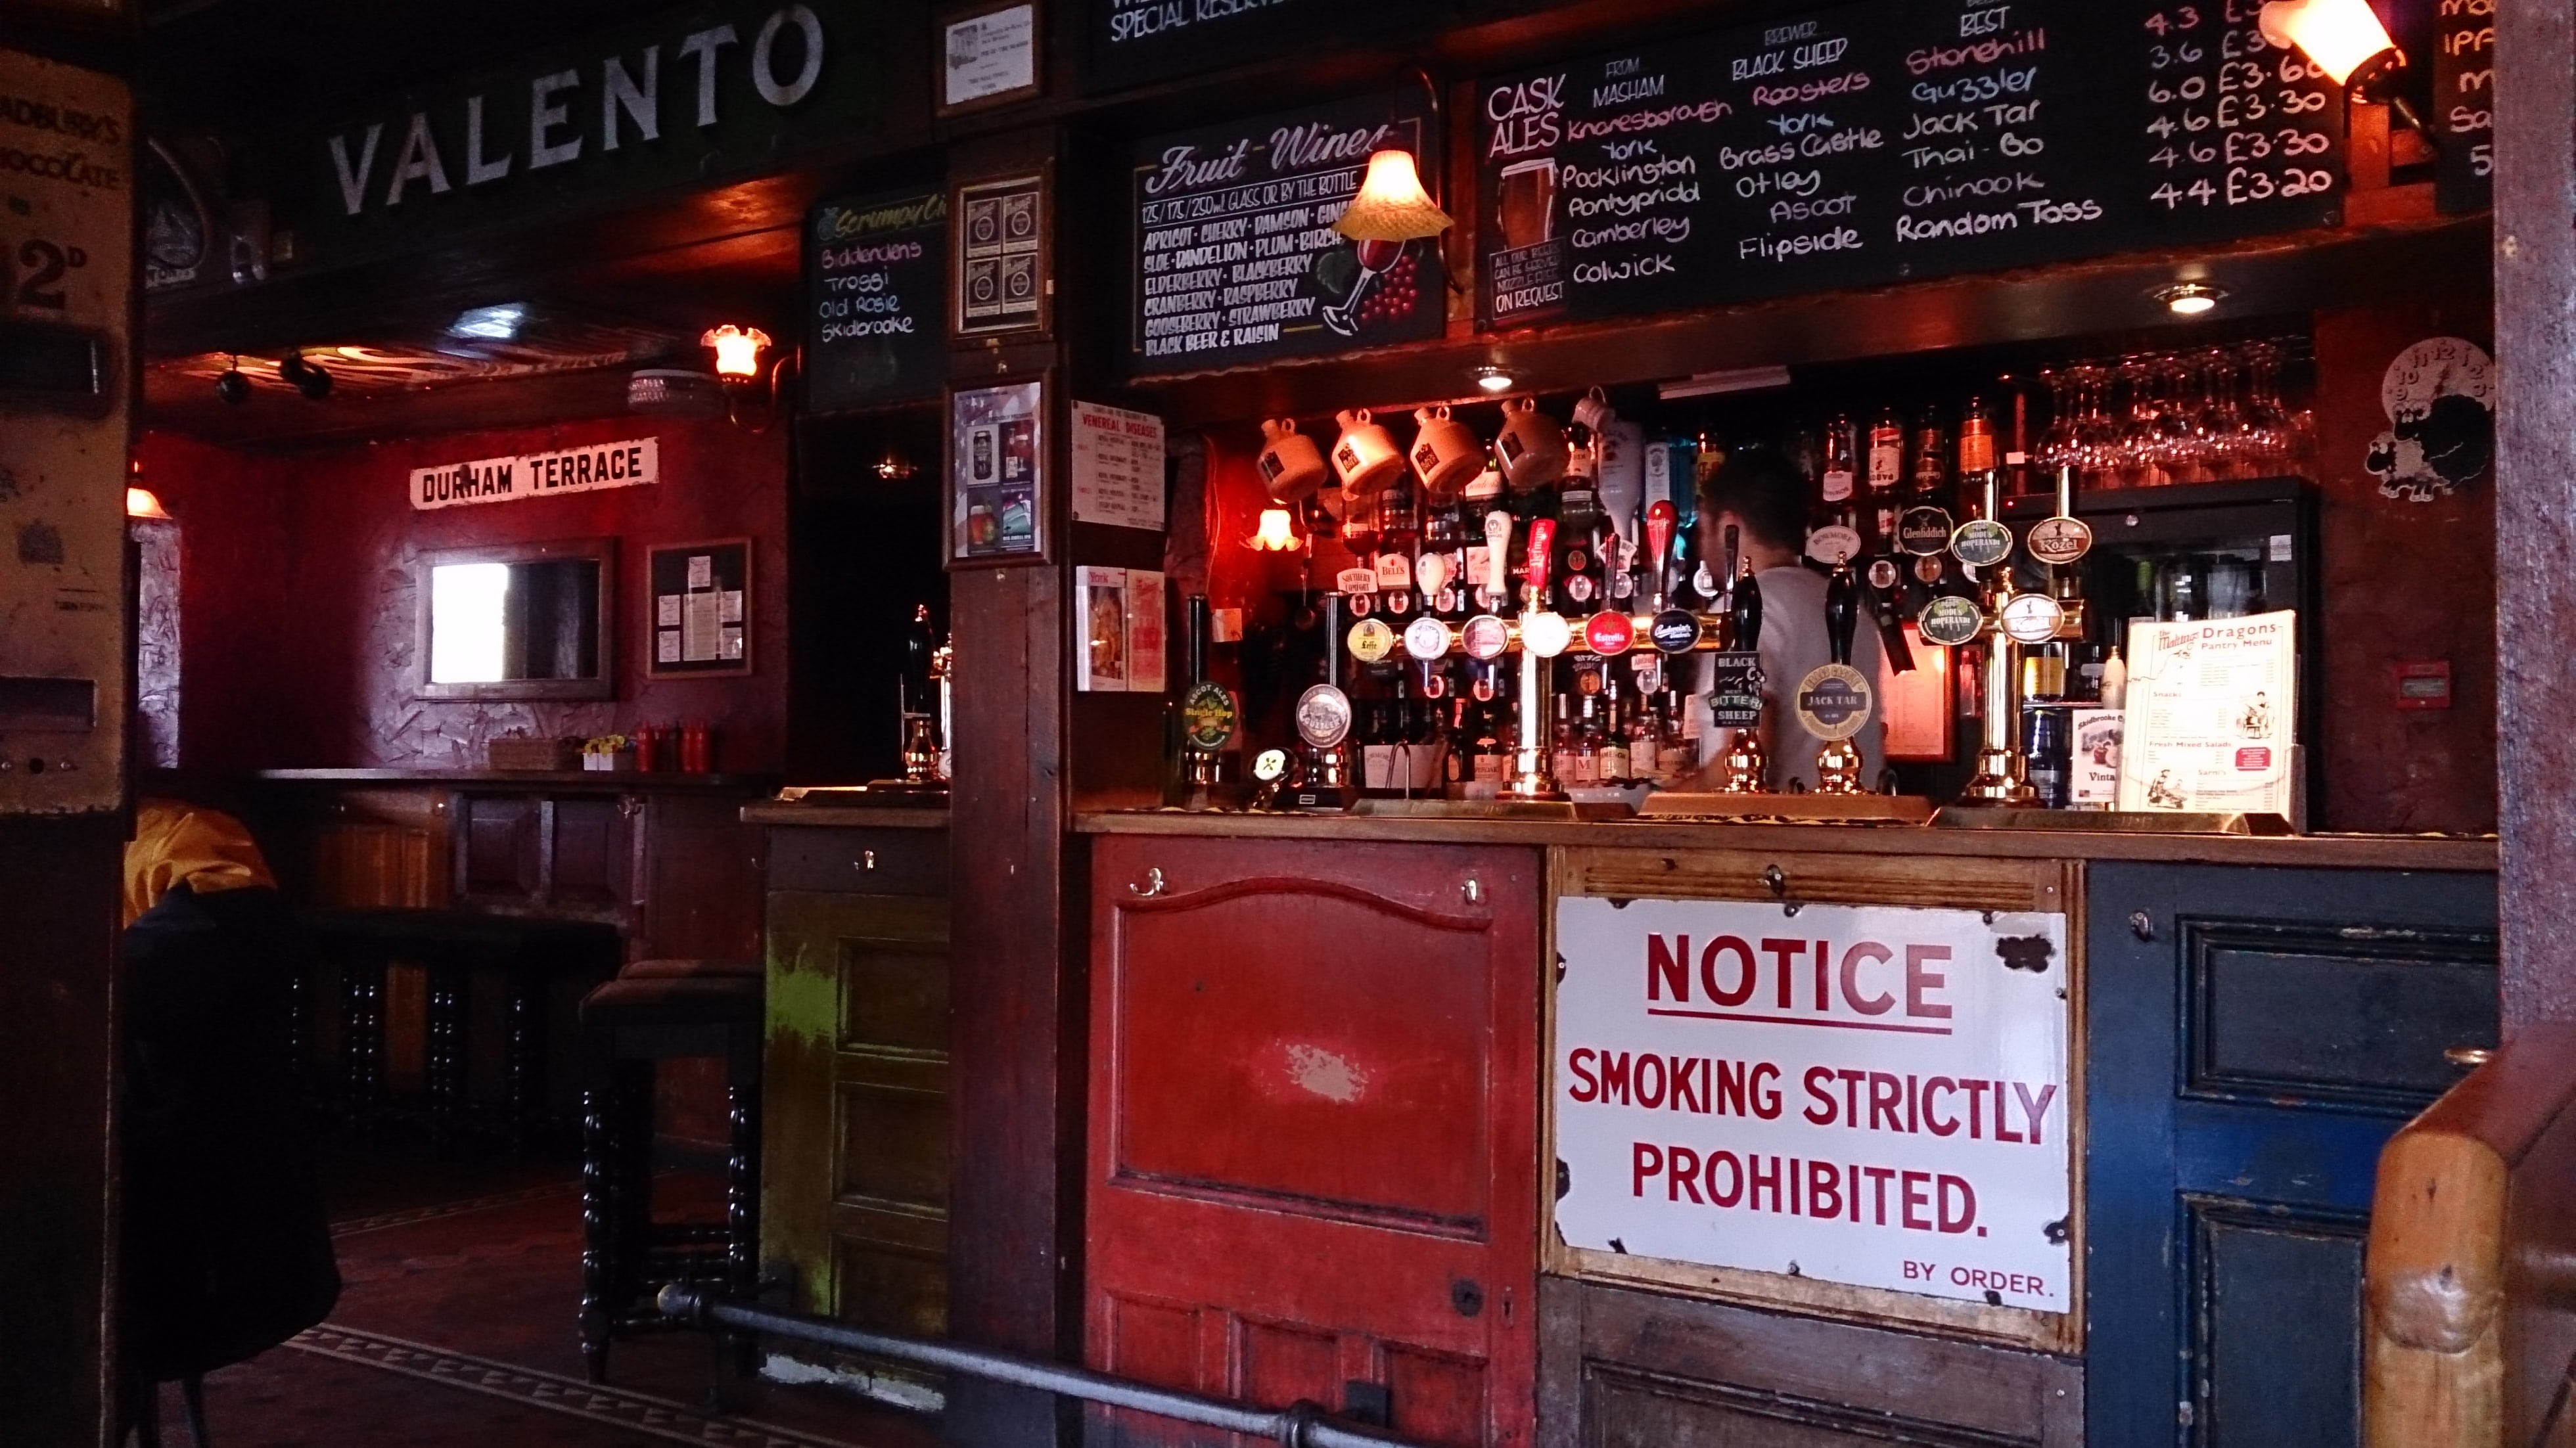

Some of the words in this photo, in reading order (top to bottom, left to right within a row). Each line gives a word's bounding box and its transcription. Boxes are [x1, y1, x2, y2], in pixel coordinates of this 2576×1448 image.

[1111, 1, 1190, 42] SPECIAL
[1960, 6, 2012, 37] BEST
[1606, 57, 1640, 78] FROM
[1732, 50, 1785, 81] BLACK
[1793, 37, 1849, 70] SHEEP
[1906, 28, 2045, 75] Stonehill
[2150, 41, 2203, 68] 3.6
[1488, 74, 1567, 121] CASK
[1593, 74, 1665, 108] MASHAM
[1753, 72, 1871, 106] Roosters
[2149, 76, 2206, 103] 6.0
[329, 5, 824, 215] VALENTO
[1568, 100, 1733, 142] Knaresborough
[1903, 112, 1979, 140] Jack
[1984, 99, 2041, 126] Tar
[2147, 108, 2211, 139] 4.6
[1490, 111, 1560, 158] ALES
[1720, 141, 1795, 170] Brass
[1801, 127, 1884, 157] Castle
[1902, 139, 1975, 169] Thai
[2000, 132, 2044, 157] Bo
[1145, 139, 1249, 194] Fruit
[1562, 154, 1696, 189] Pocklington
[2148, 141, 2217, 169] 4.6
[1228, 188, 1260, 211] GLASS
[1263, 185, 1276, 202] OR
[1281, 182, 1296, 200] BY
[1298, 176, 1318, 197] THE
[1319, 171, 1358, 195] BOTTLE
[1569, 181, 1701, 217] Pontypridd
[1736, 170, 1821, 198] Otley
[1903, 172, 2046, 207] Chinook
[2150, 178, 2217, 210] 4.4
[1144, 227, 1195, 252] APRICOT
[1201, 223, 1247, 244] CHERRY
[1254, 207, 1308, 235] DAMSON
[1572, 216, 1690, 248] Camberley
[1897, 212, 2018, 242] Random
[2017, 199, 2104, 224] Toss
[1144, 252, 1171, 274] SLOE
[1176, 242, 1248, 269] DANDELION
[1254, 233, 1295, 258] PLUM
[1739, 226, 1864, 263] Flipside
[1145, 267, 1222, 296] ELDERBERRY
[1232, 254, 1313, 284] BLACKBERRY
[1574, 254, 1676, 283] Colwick
[819, 298, 848, 319] Old
[856, 293, 900, 313] Rosie
[1144, 290, 1216, 317] CRANBERRY
[1224, 278, 1299, 307] RASPBERRY
[1496, 292, 1513, 313] ON
[1515, 281, 1565, 308] REQUEST
[1145, 311, 1221, 338] GOOSEBERRY
[1228, 297, 1316, 327] STRAWBERRY
[1145, 335, 1182, 357] BLACK
[1185, 329, 1218, 351] BEER
[1220, 328, 1230, 348] &
[1233, 323, 1279, 347] RAISIN
[2433, 343, 2456, 360] 12
[422, 464, 513, 503] DURHAM
[530, 447, 643, 489] TERRACE
[1903, 527, 1947, 539] Glenfiddich
[2040, 539, 2079, 553] Kozel
[1089, 571, 1109, 584] York
[1382, 565, 1405, 576] BELL'S
[2203, 623, 2276, 640] Dragons
[2243, 639, 2272, 647] Menu
[1718, 657, 1757, 667] BLACK
[1189, 685, 1212, 705] ASCOT
[1213, 687, 1230, 706] ALES
[1710, 695, 1762, 710] BITTER
[1808, 696, 1833, 706] JACK
[1835, 696, 1857, 705] TAR
[1718, 710, 1757, 720] SHEEP
[1648, 934, 1952, 1019] NOTICE
[1569, 1048, 1782, 1120] SMOKING
[1803, 1066, 2056, 1145] STRICTLY
[1633, 1142, 1988, 1238] PROHIBITED.
[1903, 1261, 1937, 1282] BY
[1952, 1267, 2055, 1298] ORDER.
